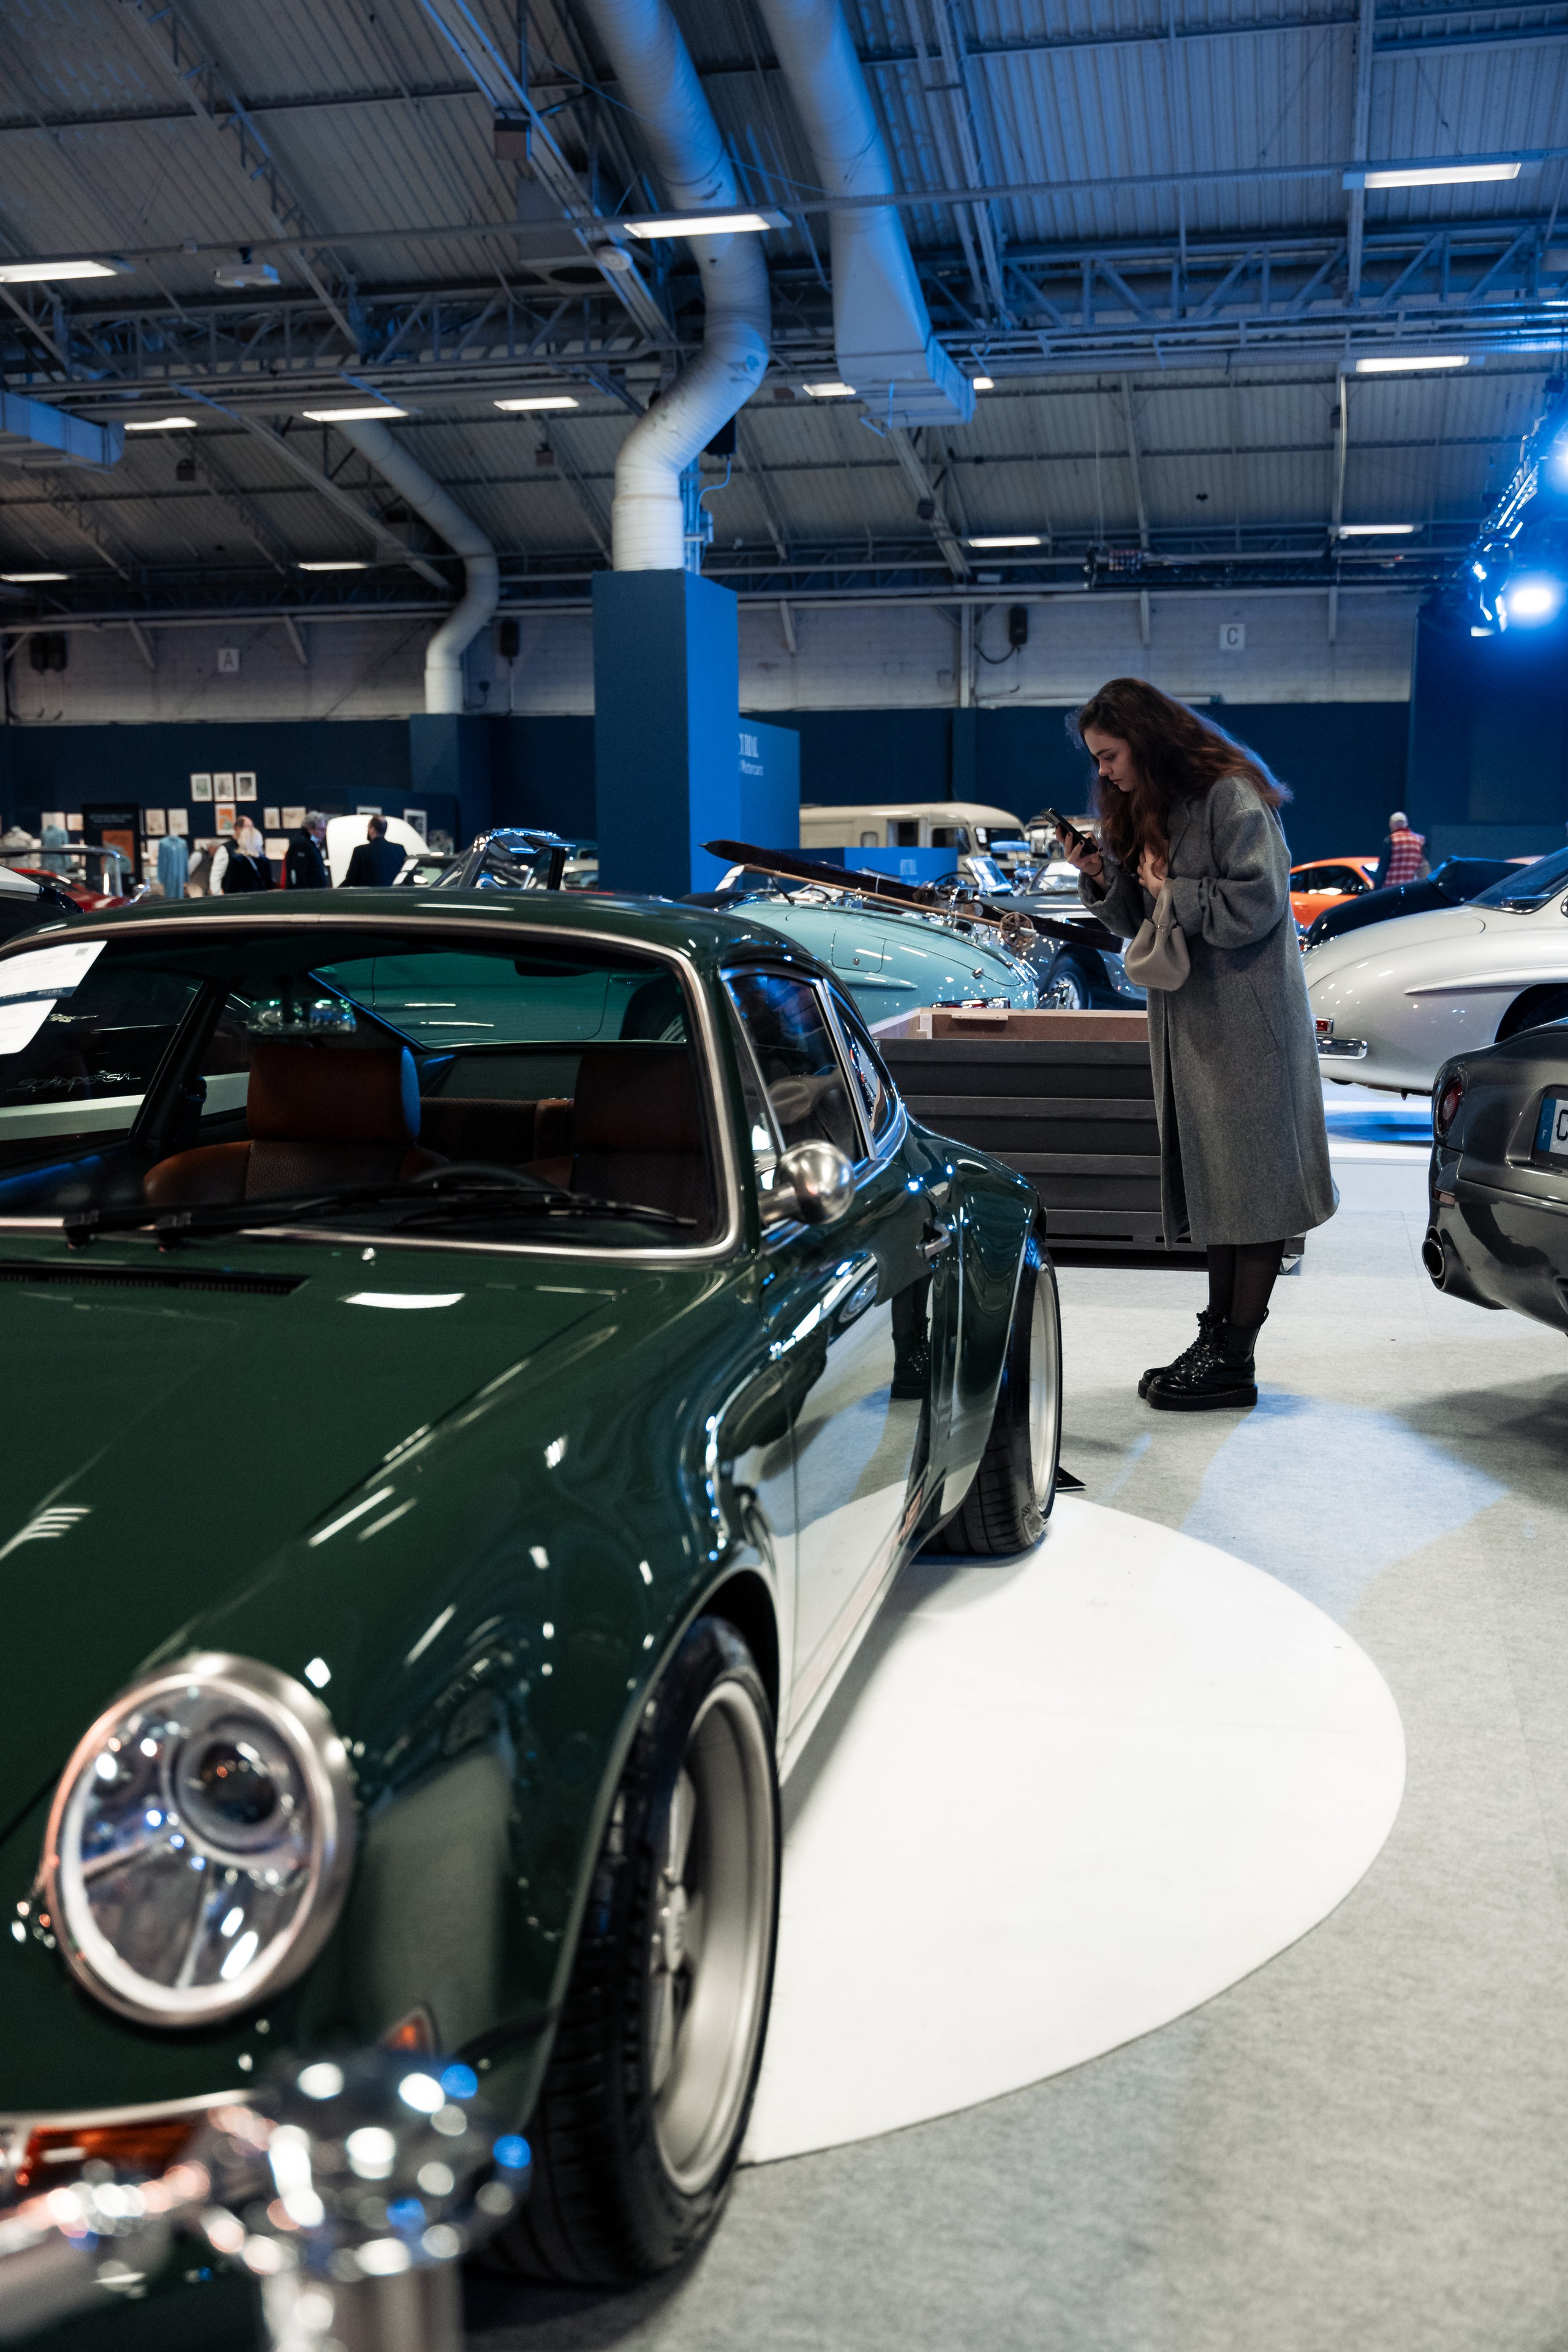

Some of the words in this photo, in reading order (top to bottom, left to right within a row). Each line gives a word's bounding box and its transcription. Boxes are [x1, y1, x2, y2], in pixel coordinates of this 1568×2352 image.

[1227, 627, 1238, 646] C
[223, 652, 235, 669] A
[1542, 1129, 1548, 1139] F
